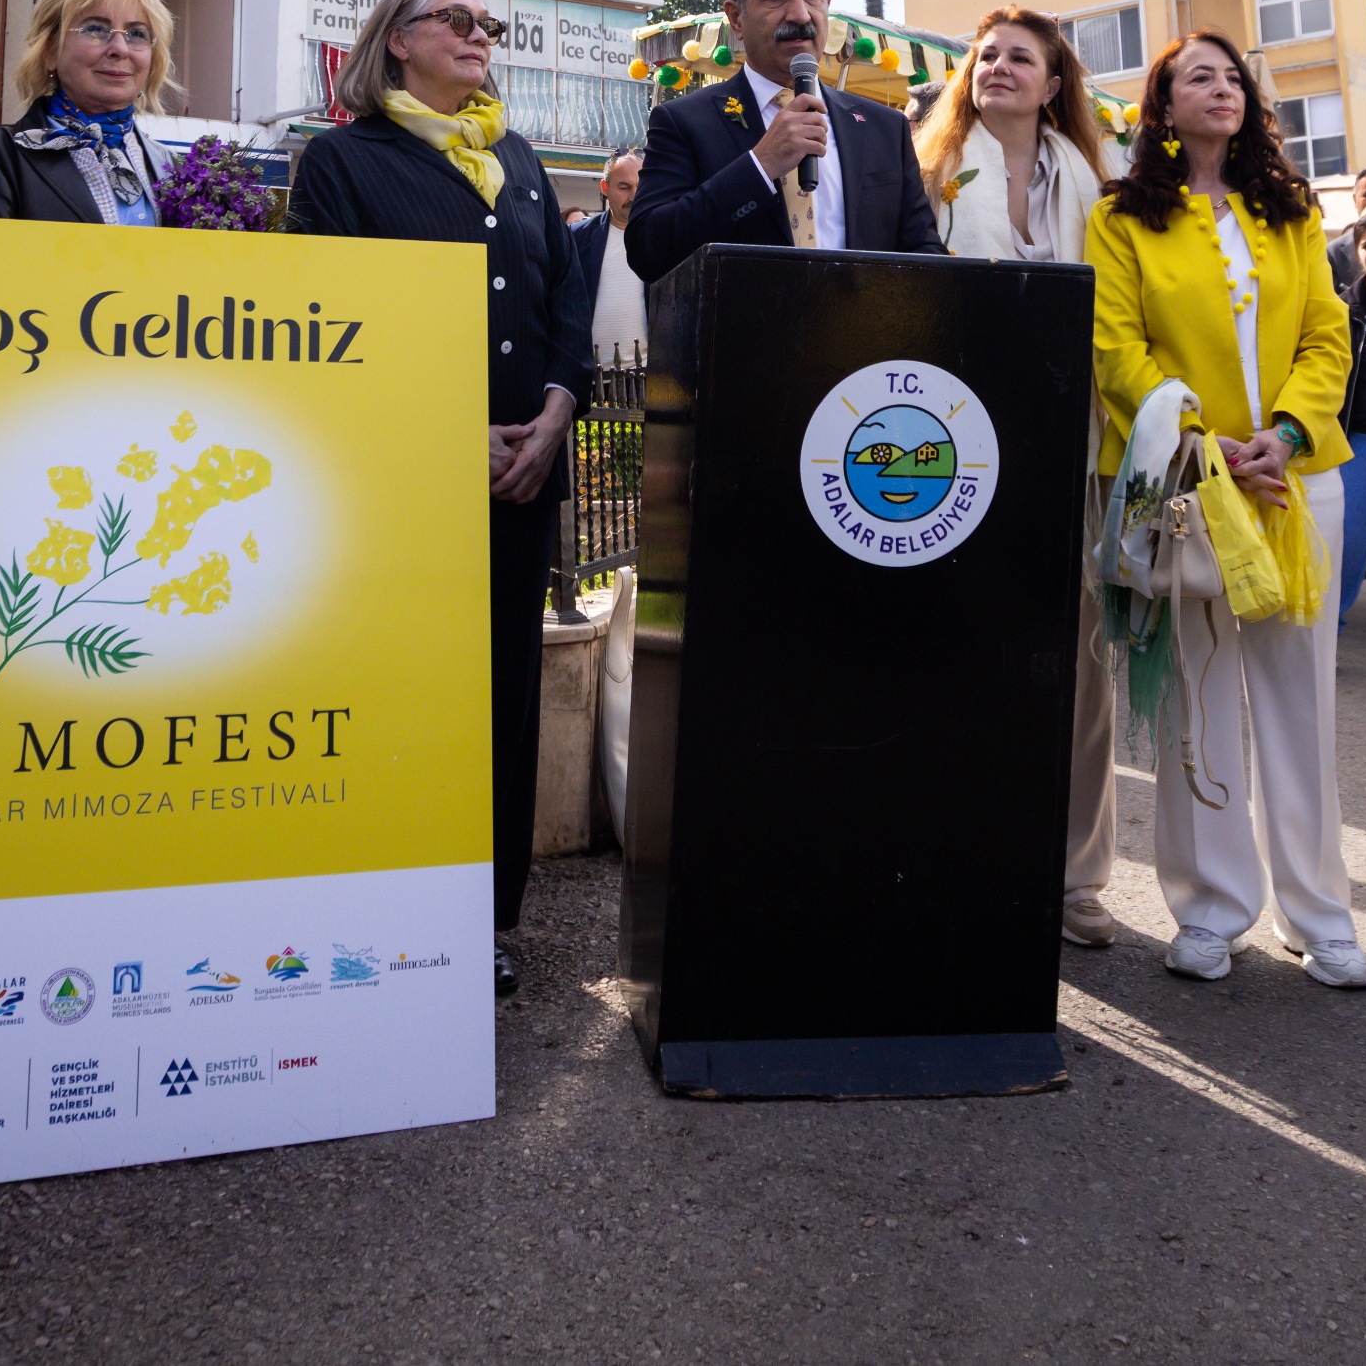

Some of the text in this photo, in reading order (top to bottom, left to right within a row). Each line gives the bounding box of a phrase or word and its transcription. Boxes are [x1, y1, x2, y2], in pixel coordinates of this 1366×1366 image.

[520, 13, 543, 22] 1974
[499, 11, 543, 54] aba
[561, 41, 585, 59] Ice
[80, 290, 365, 364] Geldiniz
[885, 373, 924, 394] T.C.
[822, 472, 979, 555] ADALAR BELEDİYESİ
[45, 790, 175, 822] MİMOZA
[192, 779, 346, 812] FESTİVALİ
[390, 953, 450, 971] mimoz.ada
[254, 982, 322, 996] Burgazada Gönüllüleri
[330, 983, 353, 991] cesaret
[189, 994, 234, 1007] ADELSAD
[0, 1017, 25, 1027] DERNEĞİ
[52, 1059, 99, 1073] GENÇLİK
[205, 1055, 258, 1073] ENSTİTÜ
[51, 1073, 98, 1086] VE SPOR
[205, 1071, 266, 1087] İSTANBUL
[50, 1081, 115, 1100] HİZMETLERİ
[49, 1097, 93, 1112] DAİRESİ
[49, 1109, 116, 1125] BAŞKANLIĞI
